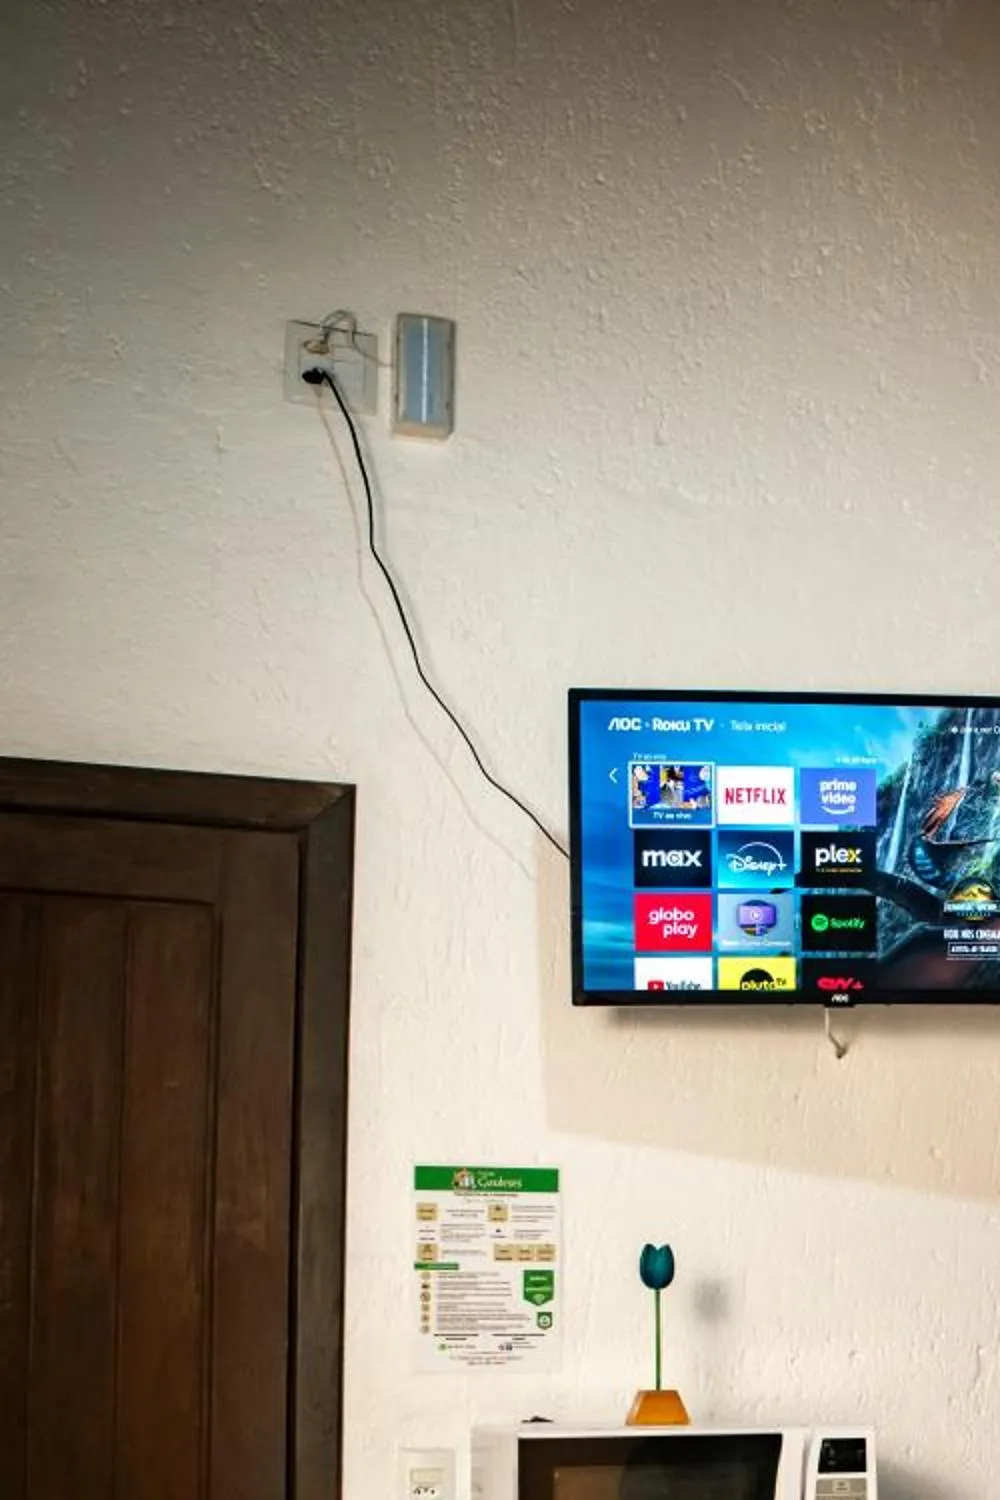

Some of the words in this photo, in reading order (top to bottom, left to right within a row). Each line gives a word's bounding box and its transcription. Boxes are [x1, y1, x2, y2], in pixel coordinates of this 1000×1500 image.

[608, 717, 641, 731] AOC
[652, 717, 690, 732] Roku
[694, 717, 714, 731] TV
[730, 719, 752, 731] Tela
[755, 720, 787, 733] inicial
[820, 778, 857, 792] prime
[725, 787, 787, 805] NETFLIX
[821, 791, 856, 804] video
[653, 811, 664, 820] TV
[642, 849, 703, 867] max
[815, 844, 862, 866] plex
[726, 853, 787, 876] Disney+
[648, 907, 695, 925] globo
[829, 917, 866, 930] Spotify
[663, 922, 698, 938] play
